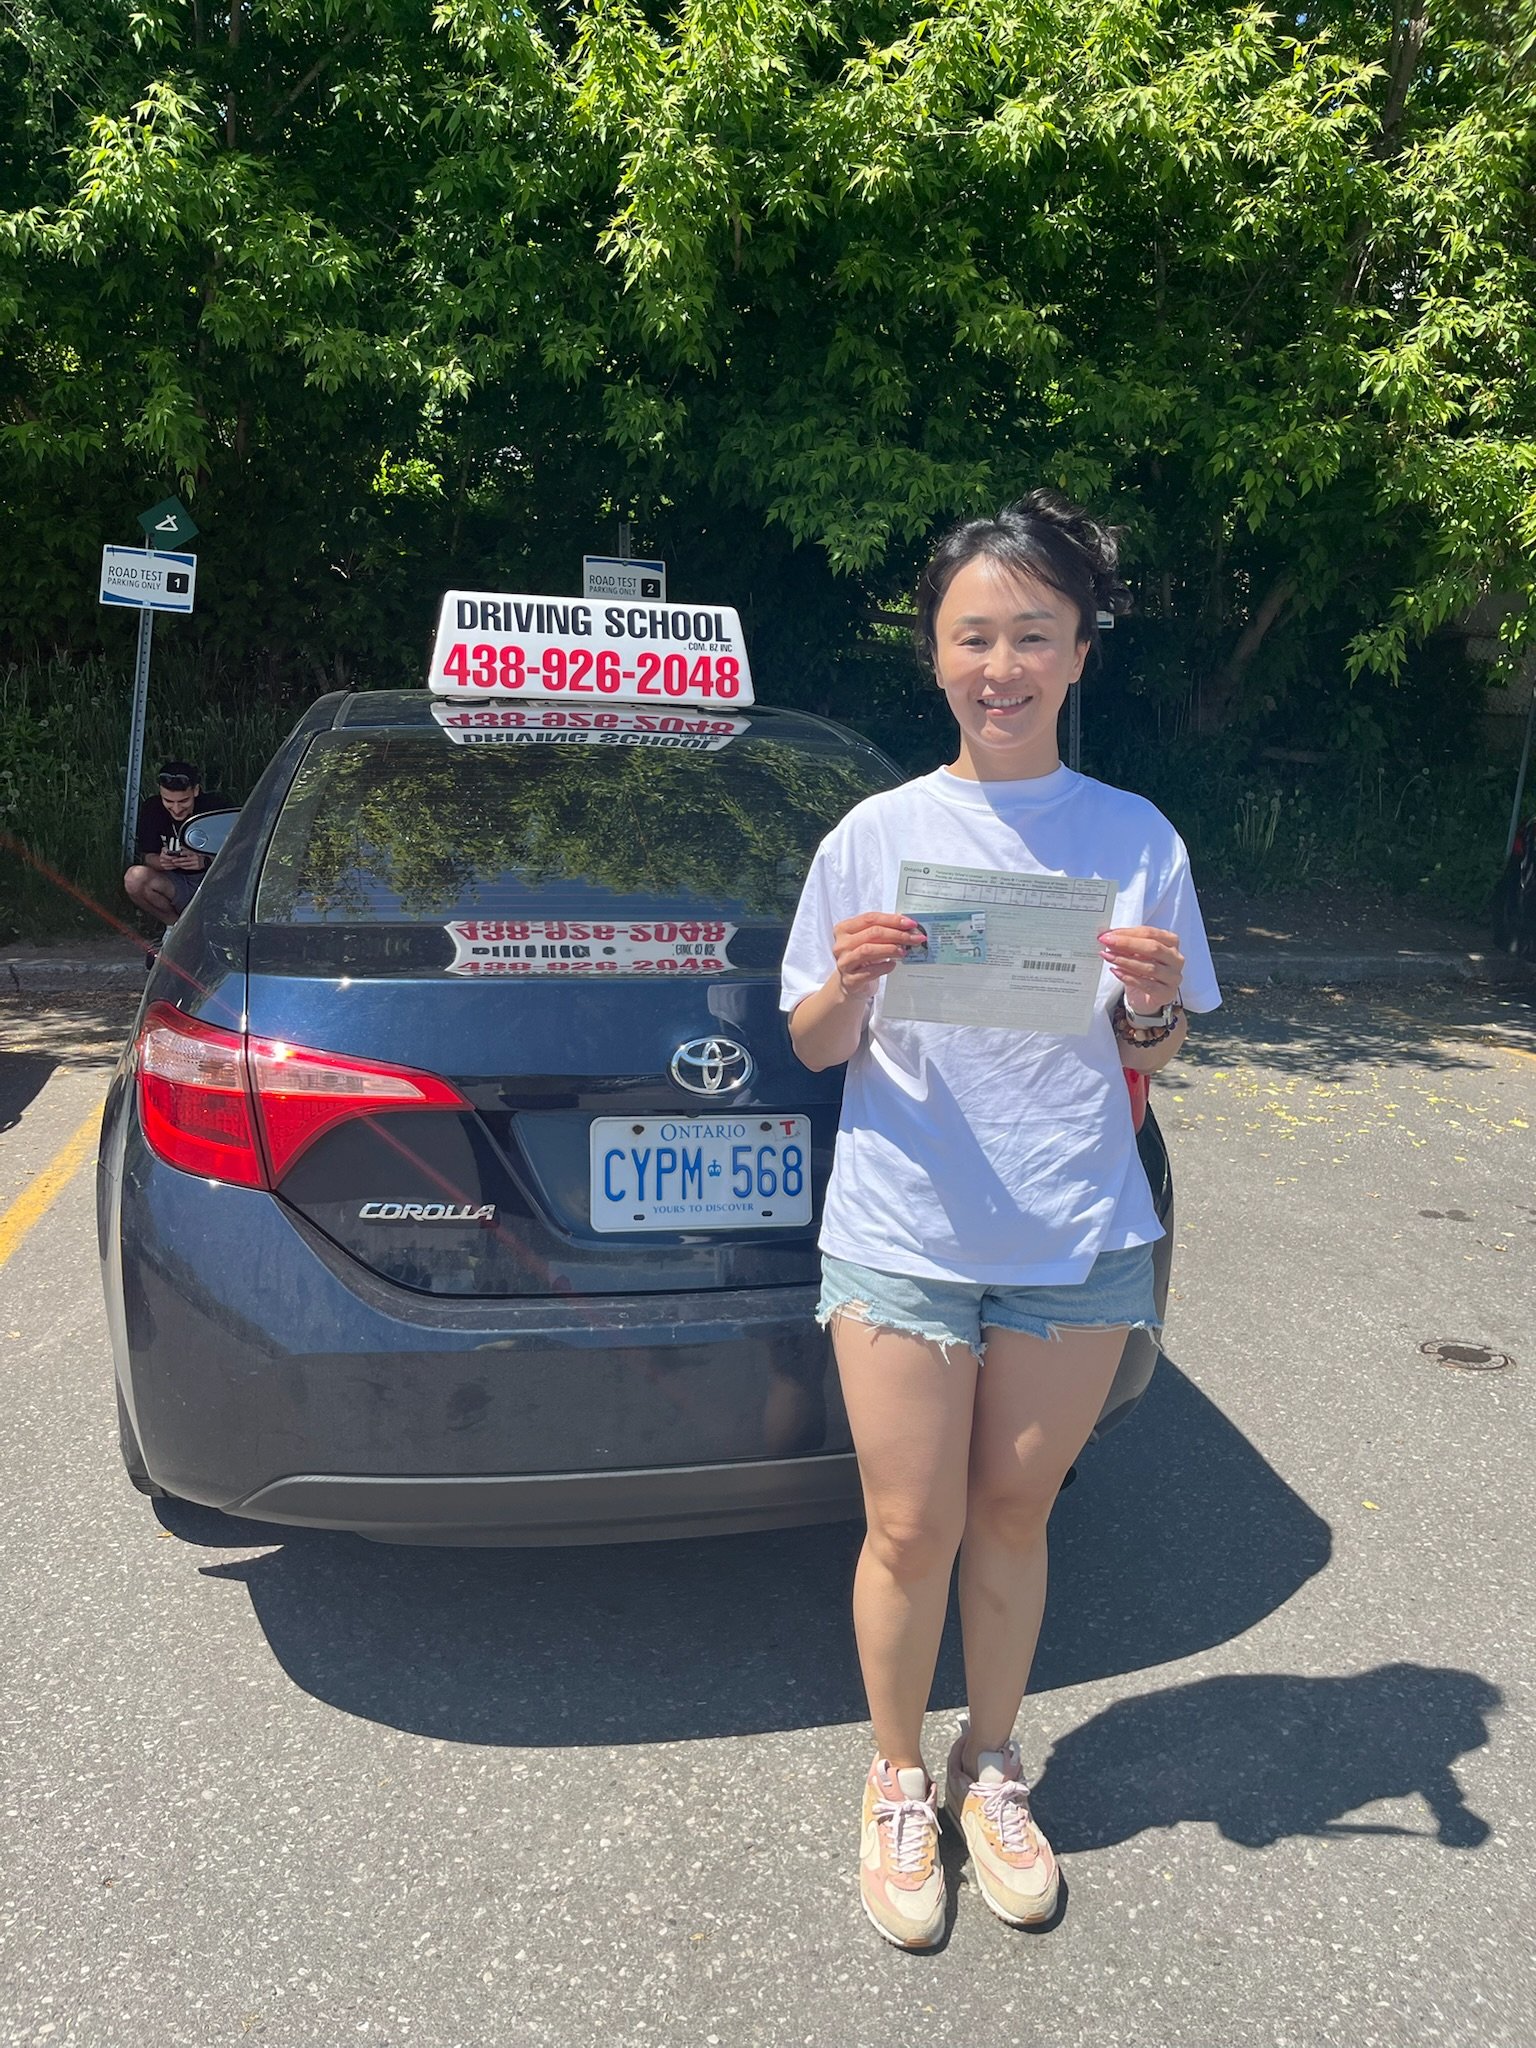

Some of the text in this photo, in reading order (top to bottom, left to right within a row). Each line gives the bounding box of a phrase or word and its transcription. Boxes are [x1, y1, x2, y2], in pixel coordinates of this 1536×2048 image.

[108, 565, 163, 582] ROAD TEST
[107, 577, 161, 591] PARKING ONLY
[174, 577, 181, 589] 1
[589, 574, 637, 588] ROAD TEST
[589, 585, 637, 596] PARKING ONLY
[647, 583, 655, 594] 2
[456, 599, 732, 643] DRIVING SCHOOL
[720, 644, 733, 653] INC
[443, 643, 740, 698] 438-926-2048
[779, 1120, 795, 1136] T
[604, 1145, 803, 1202] CYPM 568
[359, 1202, 496, 1221] COROLLA
[653, 1203, 754, 1214] YOURS TO DISCOVER
